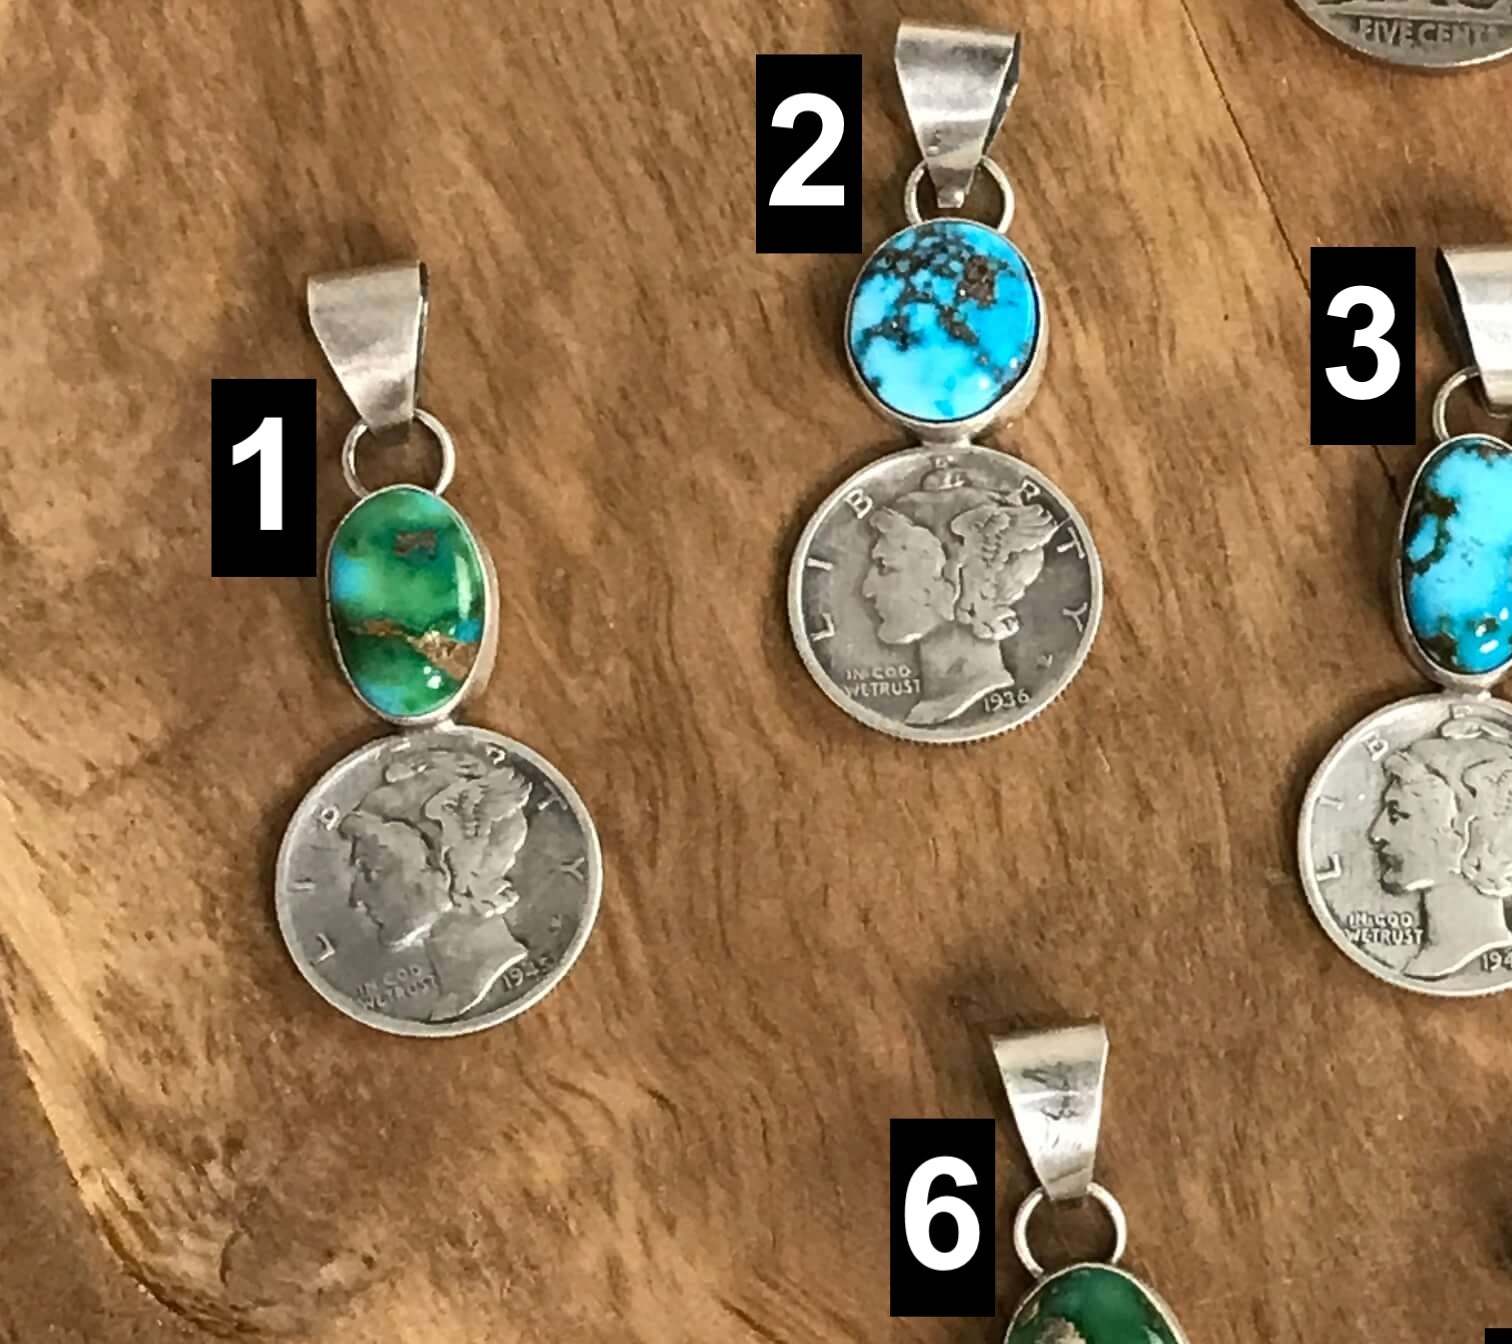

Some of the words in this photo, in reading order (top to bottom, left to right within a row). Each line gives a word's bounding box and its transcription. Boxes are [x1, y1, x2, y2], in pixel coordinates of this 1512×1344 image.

[1359, 17, 1414, 47] FIVE
[871, 678, 921, 696] TRUST
[983, 688, 1031, 713] 1936
[289, 739, 586, 962] LIBRTY
[1346, 912, 1372, 926] IN
[1374, 927, 1424, 945] TRUST
